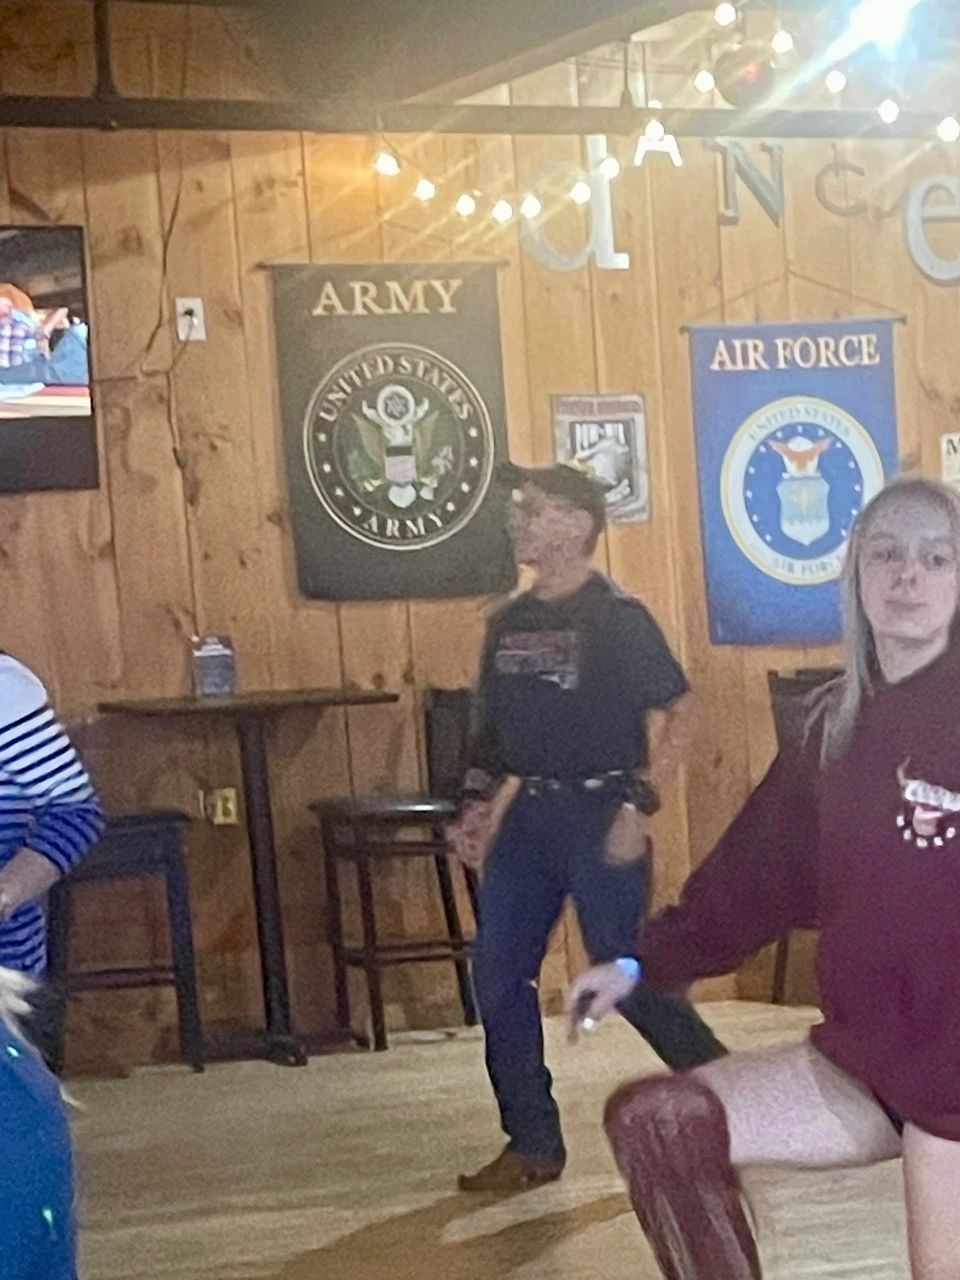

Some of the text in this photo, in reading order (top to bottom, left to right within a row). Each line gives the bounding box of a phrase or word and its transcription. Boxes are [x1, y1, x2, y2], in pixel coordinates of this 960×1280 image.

[311, 278, 464, 317] ARMY
[709, 333, 880, 371] AIR FORCE
[319, 354, 474, 423] UNITED STATES
[747, 404, 852, 442] UNITED STATES
[363, 509, 443, 538] ARMY
